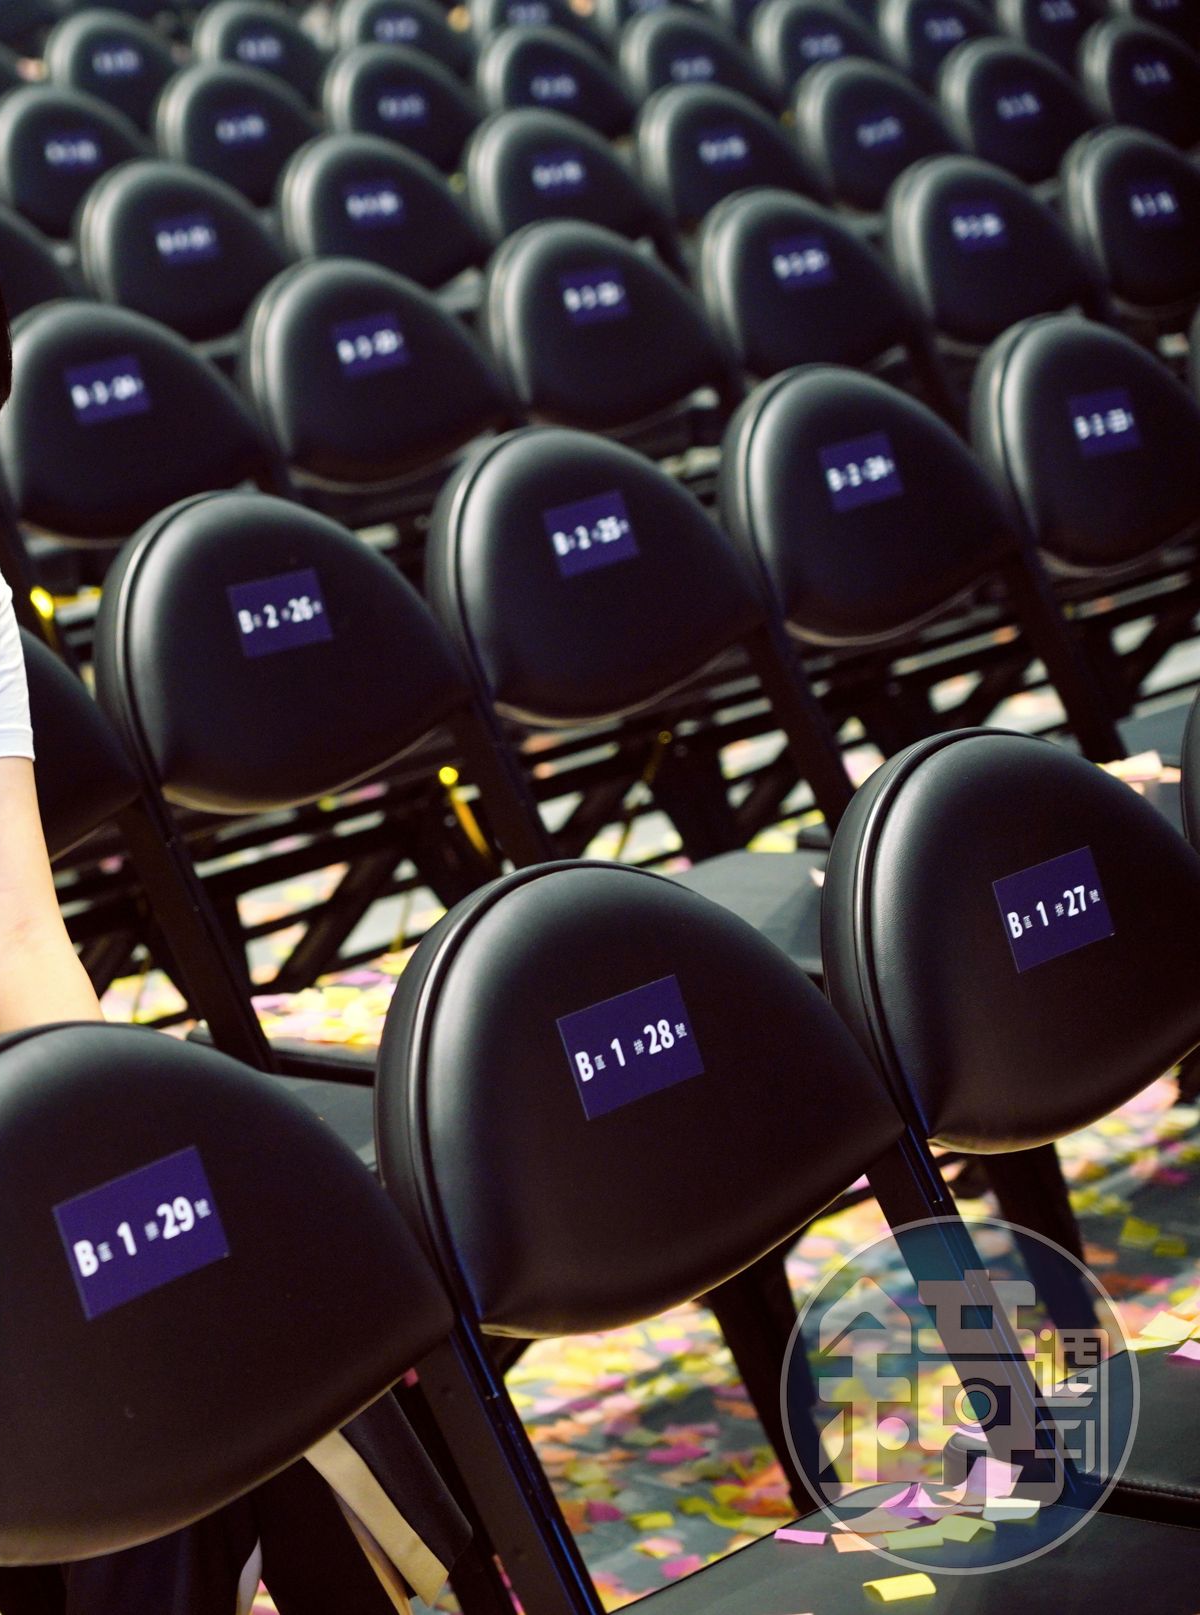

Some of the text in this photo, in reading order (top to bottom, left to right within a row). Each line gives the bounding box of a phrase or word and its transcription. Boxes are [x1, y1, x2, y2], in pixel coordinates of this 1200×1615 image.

[1036, 901, 1049, 926] 1
[610, 1038, 625, 1066] 1
[116, 1222, 137, 1256] 1
